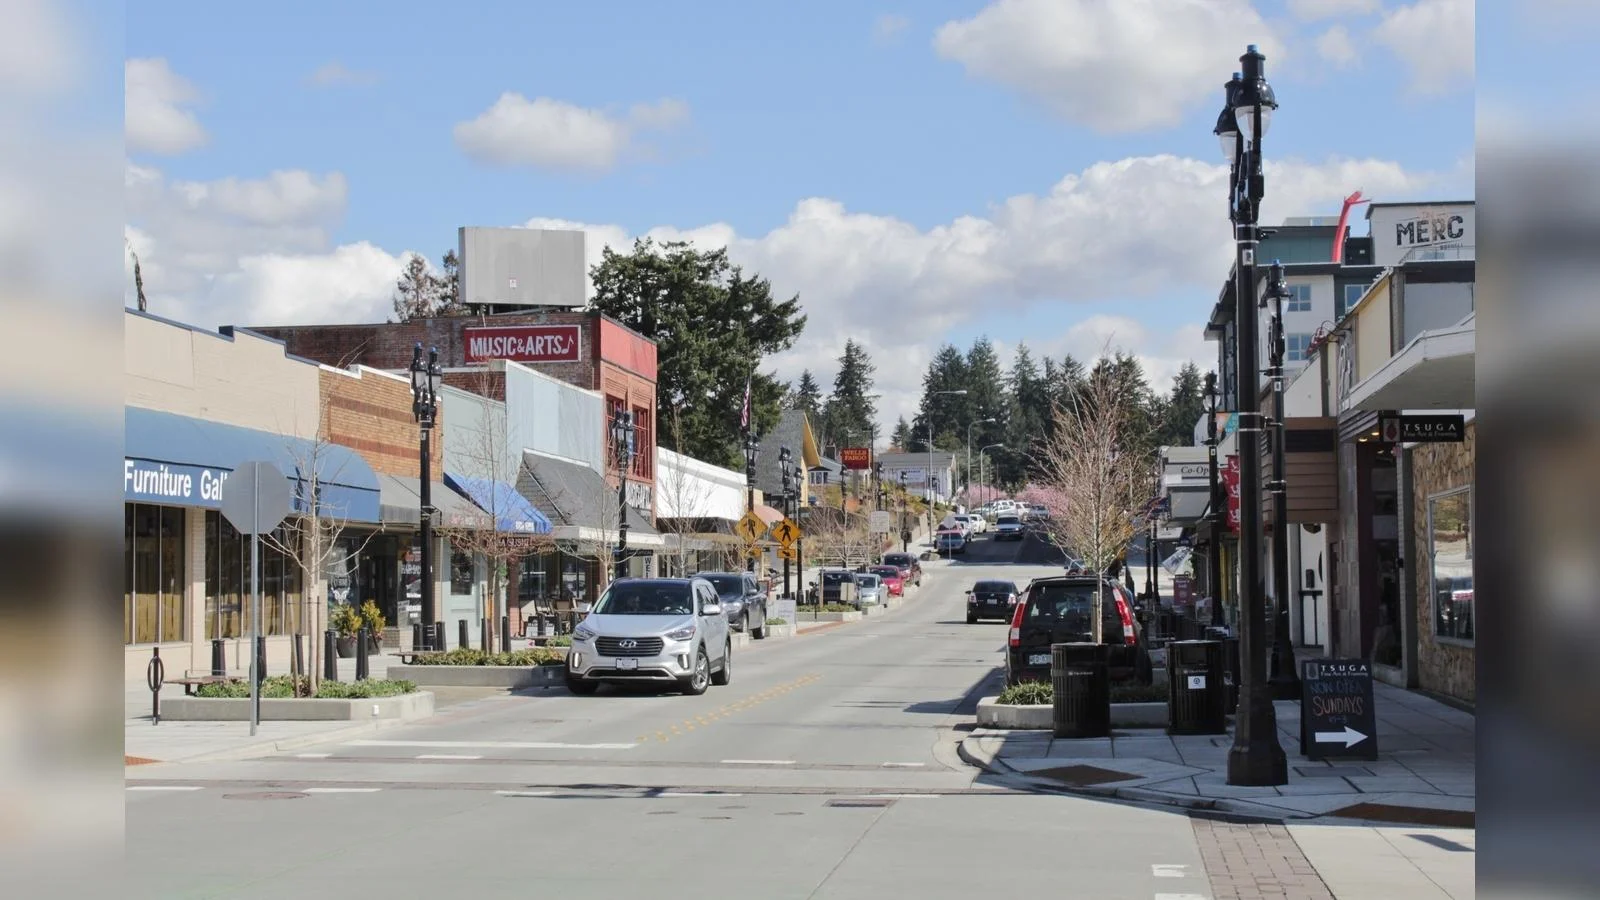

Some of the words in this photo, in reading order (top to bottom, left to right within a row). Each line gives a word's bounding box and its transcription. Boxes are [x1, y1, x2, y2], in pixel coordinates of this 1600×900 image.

[1396, 215, 1464, 246] MERC
[470, 335, 563, 357] MUSIC&ARTS
[1404, 423, 1456, 431] TSUGA
[124, 460, 192, 497] Furniture
[1181, 466, 1209, 475] Co-Op
[1312, 696, 1364, 716] SUNDAYS
